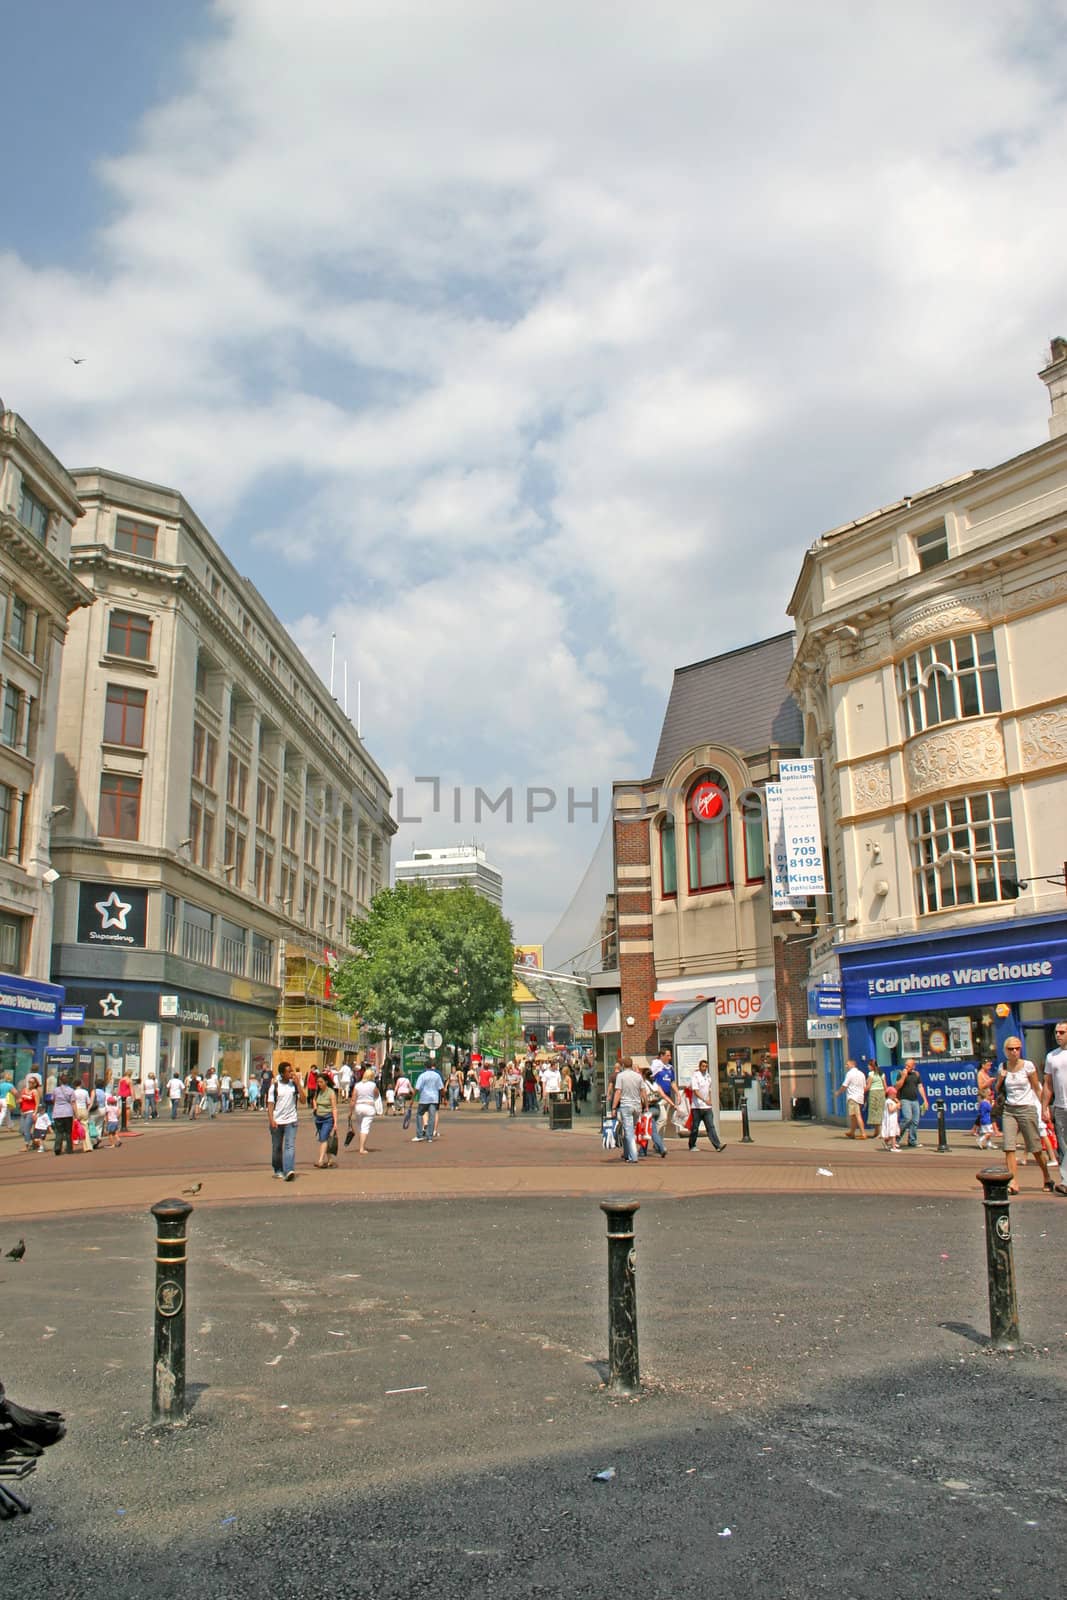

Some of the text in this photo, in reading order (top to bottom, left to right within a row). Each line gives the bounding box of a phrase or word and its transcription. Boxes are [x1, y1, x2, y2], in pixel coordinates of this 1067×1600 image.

[781, 763, 814, 773] Kings
[792, 836, 815, 844] 0151
[793, 846, 816, 856] 709
[790, 857, 821, 868] 8192
[775, 875, 788, 883] 81
[789, 874, 824, 883] Kings
[89, 931, 134, 943] Superdrug
[875, 973, 951, 994] Carphone
[952, 961, 1052, 985] Warehouse
[929, 1068, 978, 1081] we won'
[927, 1084, 979, 1097] be beate
